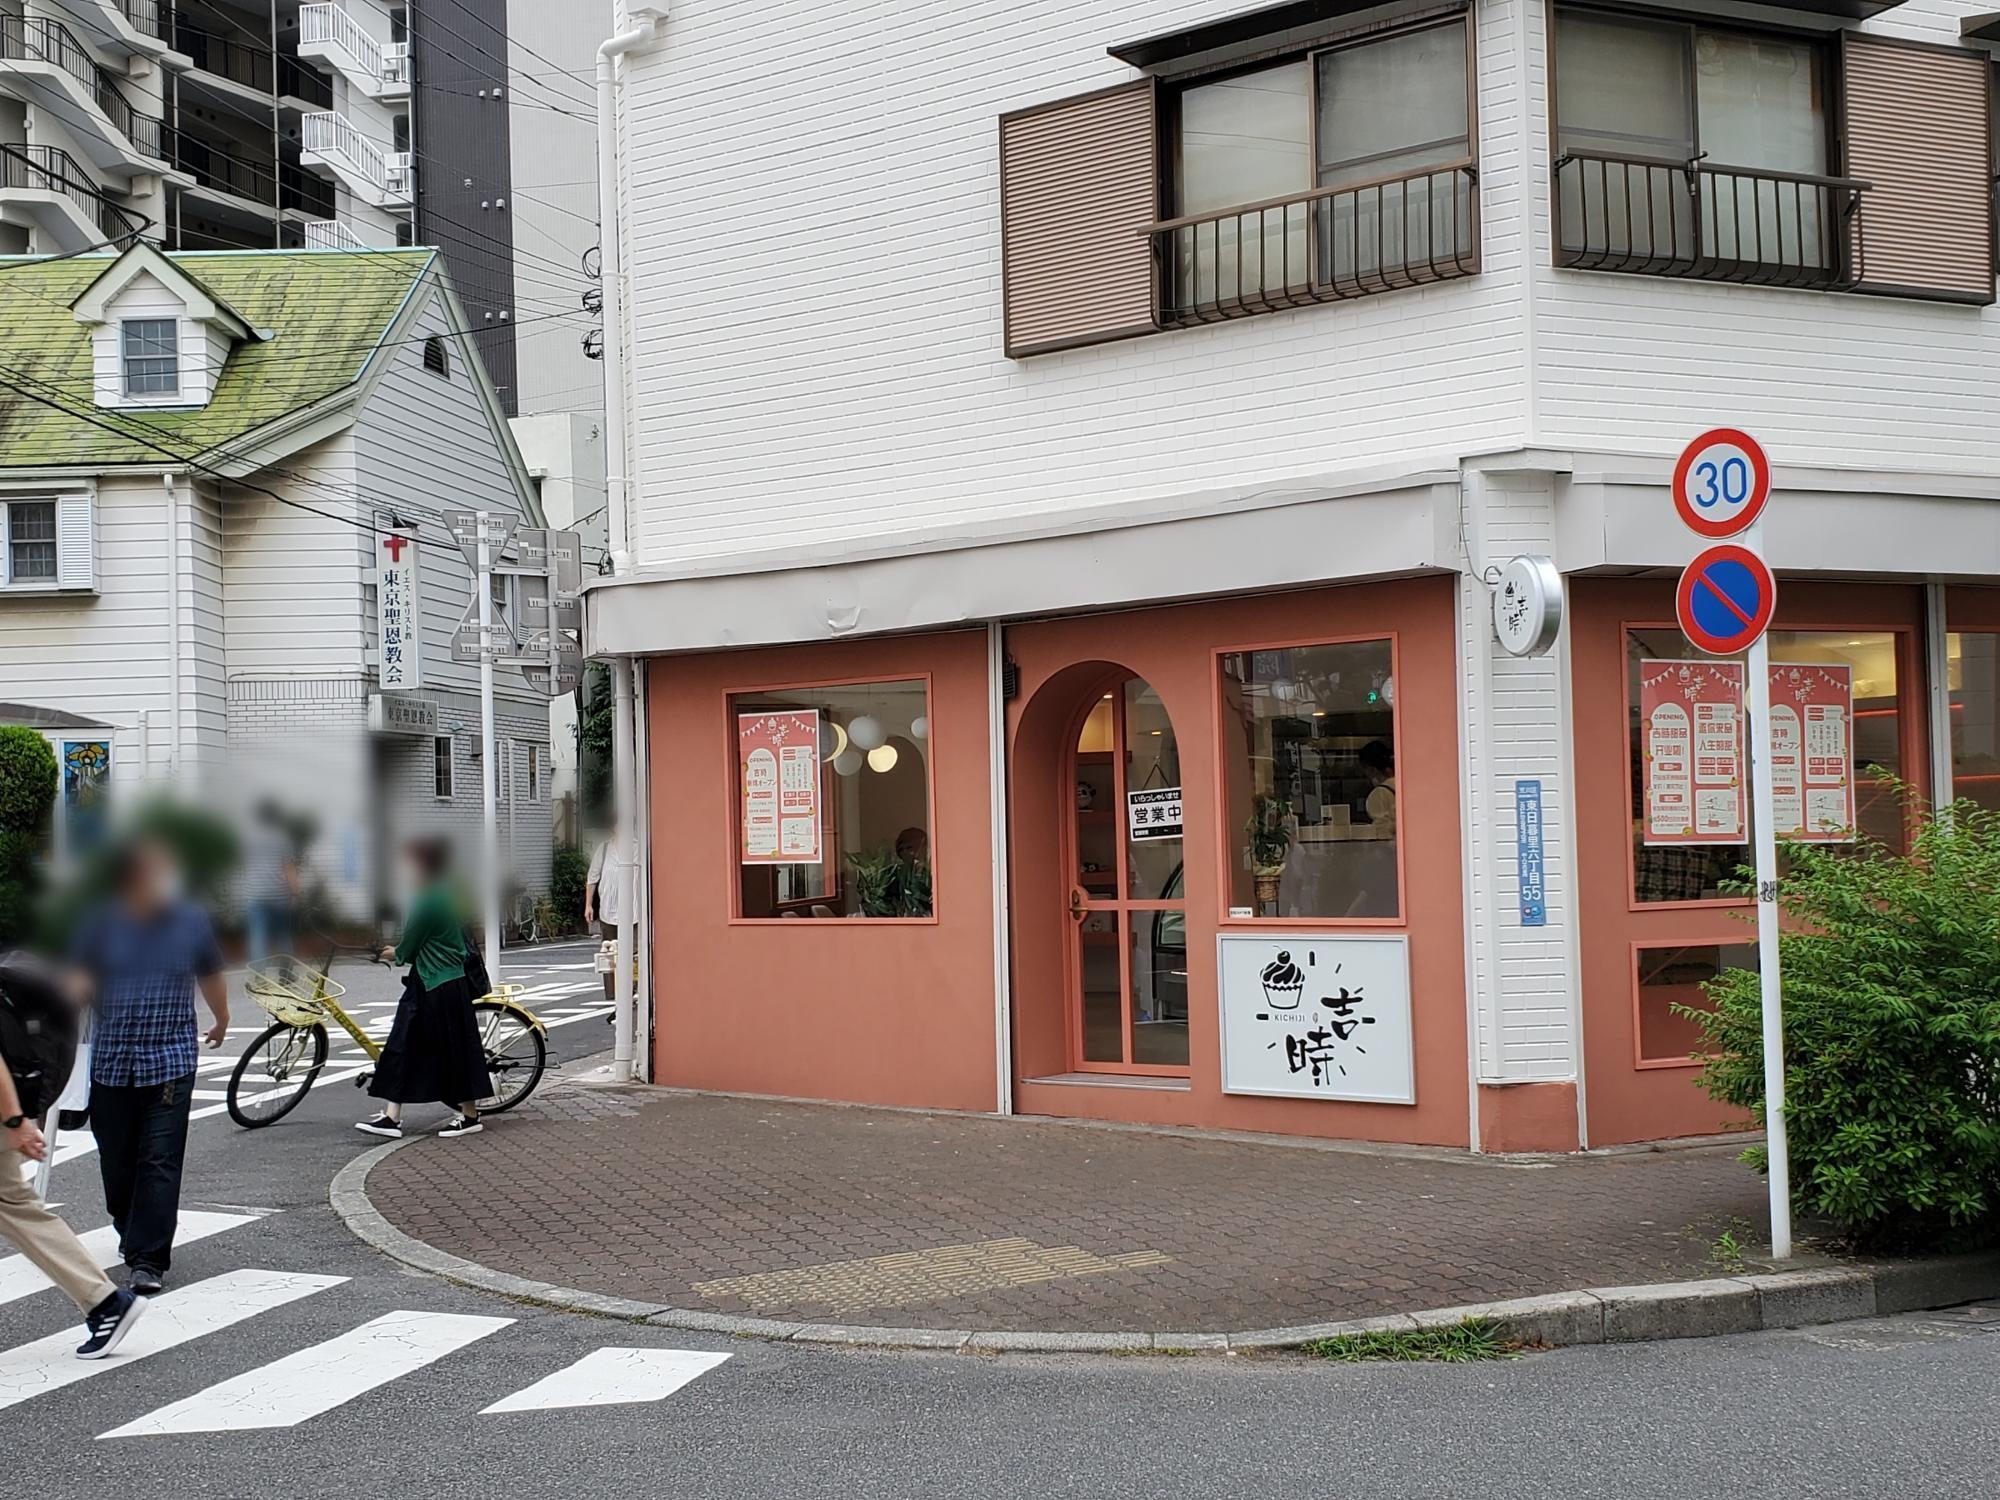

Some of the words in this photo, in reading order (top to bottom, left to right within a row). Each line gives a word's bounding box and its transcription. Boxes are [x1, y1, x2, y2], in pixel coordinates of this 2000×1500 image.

[1696, 457, 1747, 508] 30
[402, 568, 412, 640] イエス・キリスト教
[384, 569, 403, 683] 東京聖恩教会
[1134, 791, 1179, 803] いらっしゃいませ
[1134, 804, 1182, 824] 営業中
[1527, 800, 1540, 884] 東日暮里六丁目
[1522, 885, 1541, 901] 55
[1274, 1014, 1305, 1022] KICHIJI
